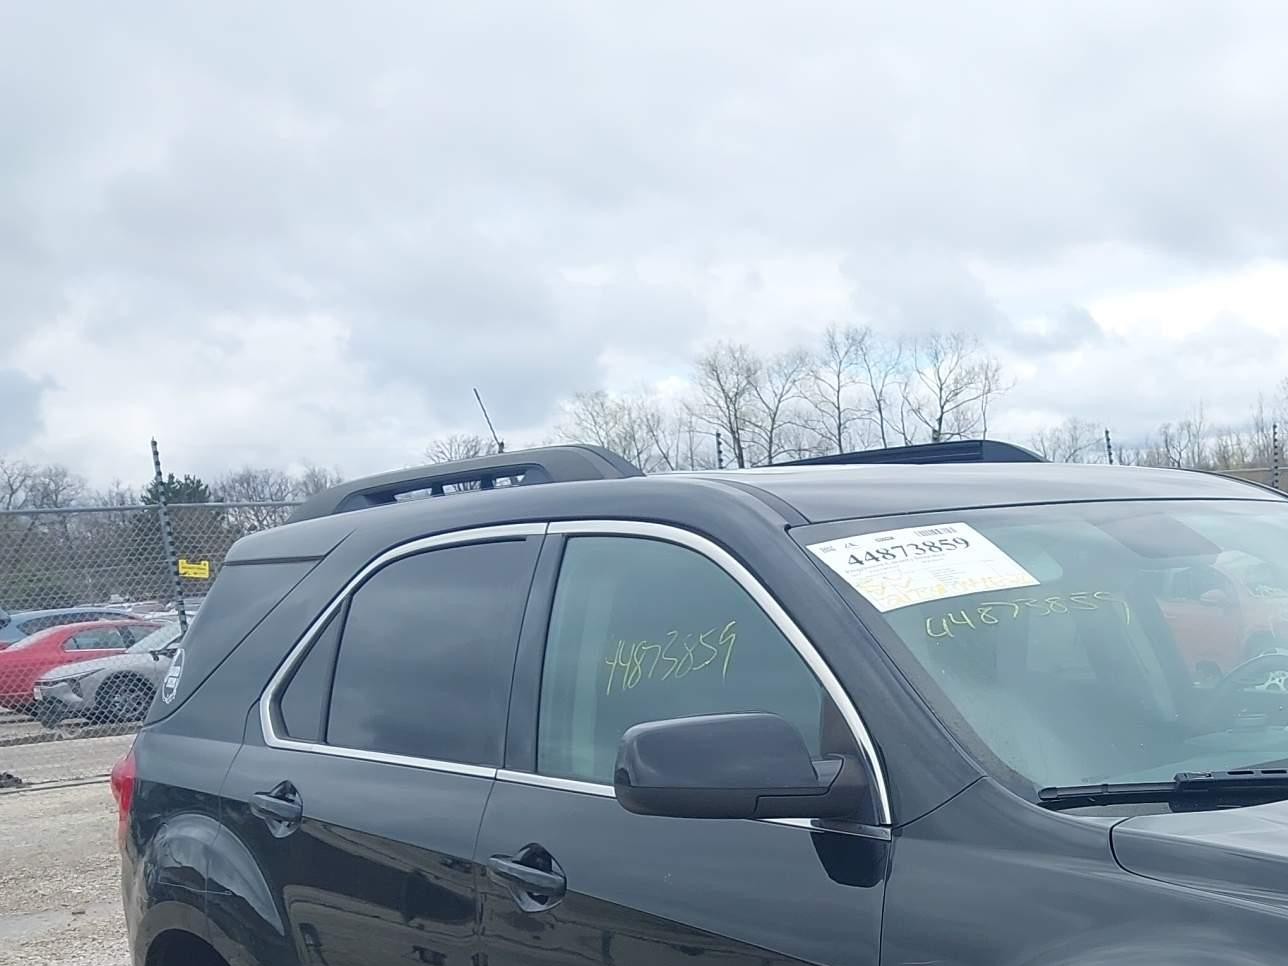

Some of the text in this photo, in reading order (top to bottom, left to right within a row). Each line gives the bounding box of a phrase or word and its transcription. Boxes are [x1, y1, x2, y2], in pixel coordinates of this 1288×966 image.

[847, 536, 970, 567] 44873859
[925, 590, 1133, 639] 44873859
[605, 620, 737, 697] 44873859
